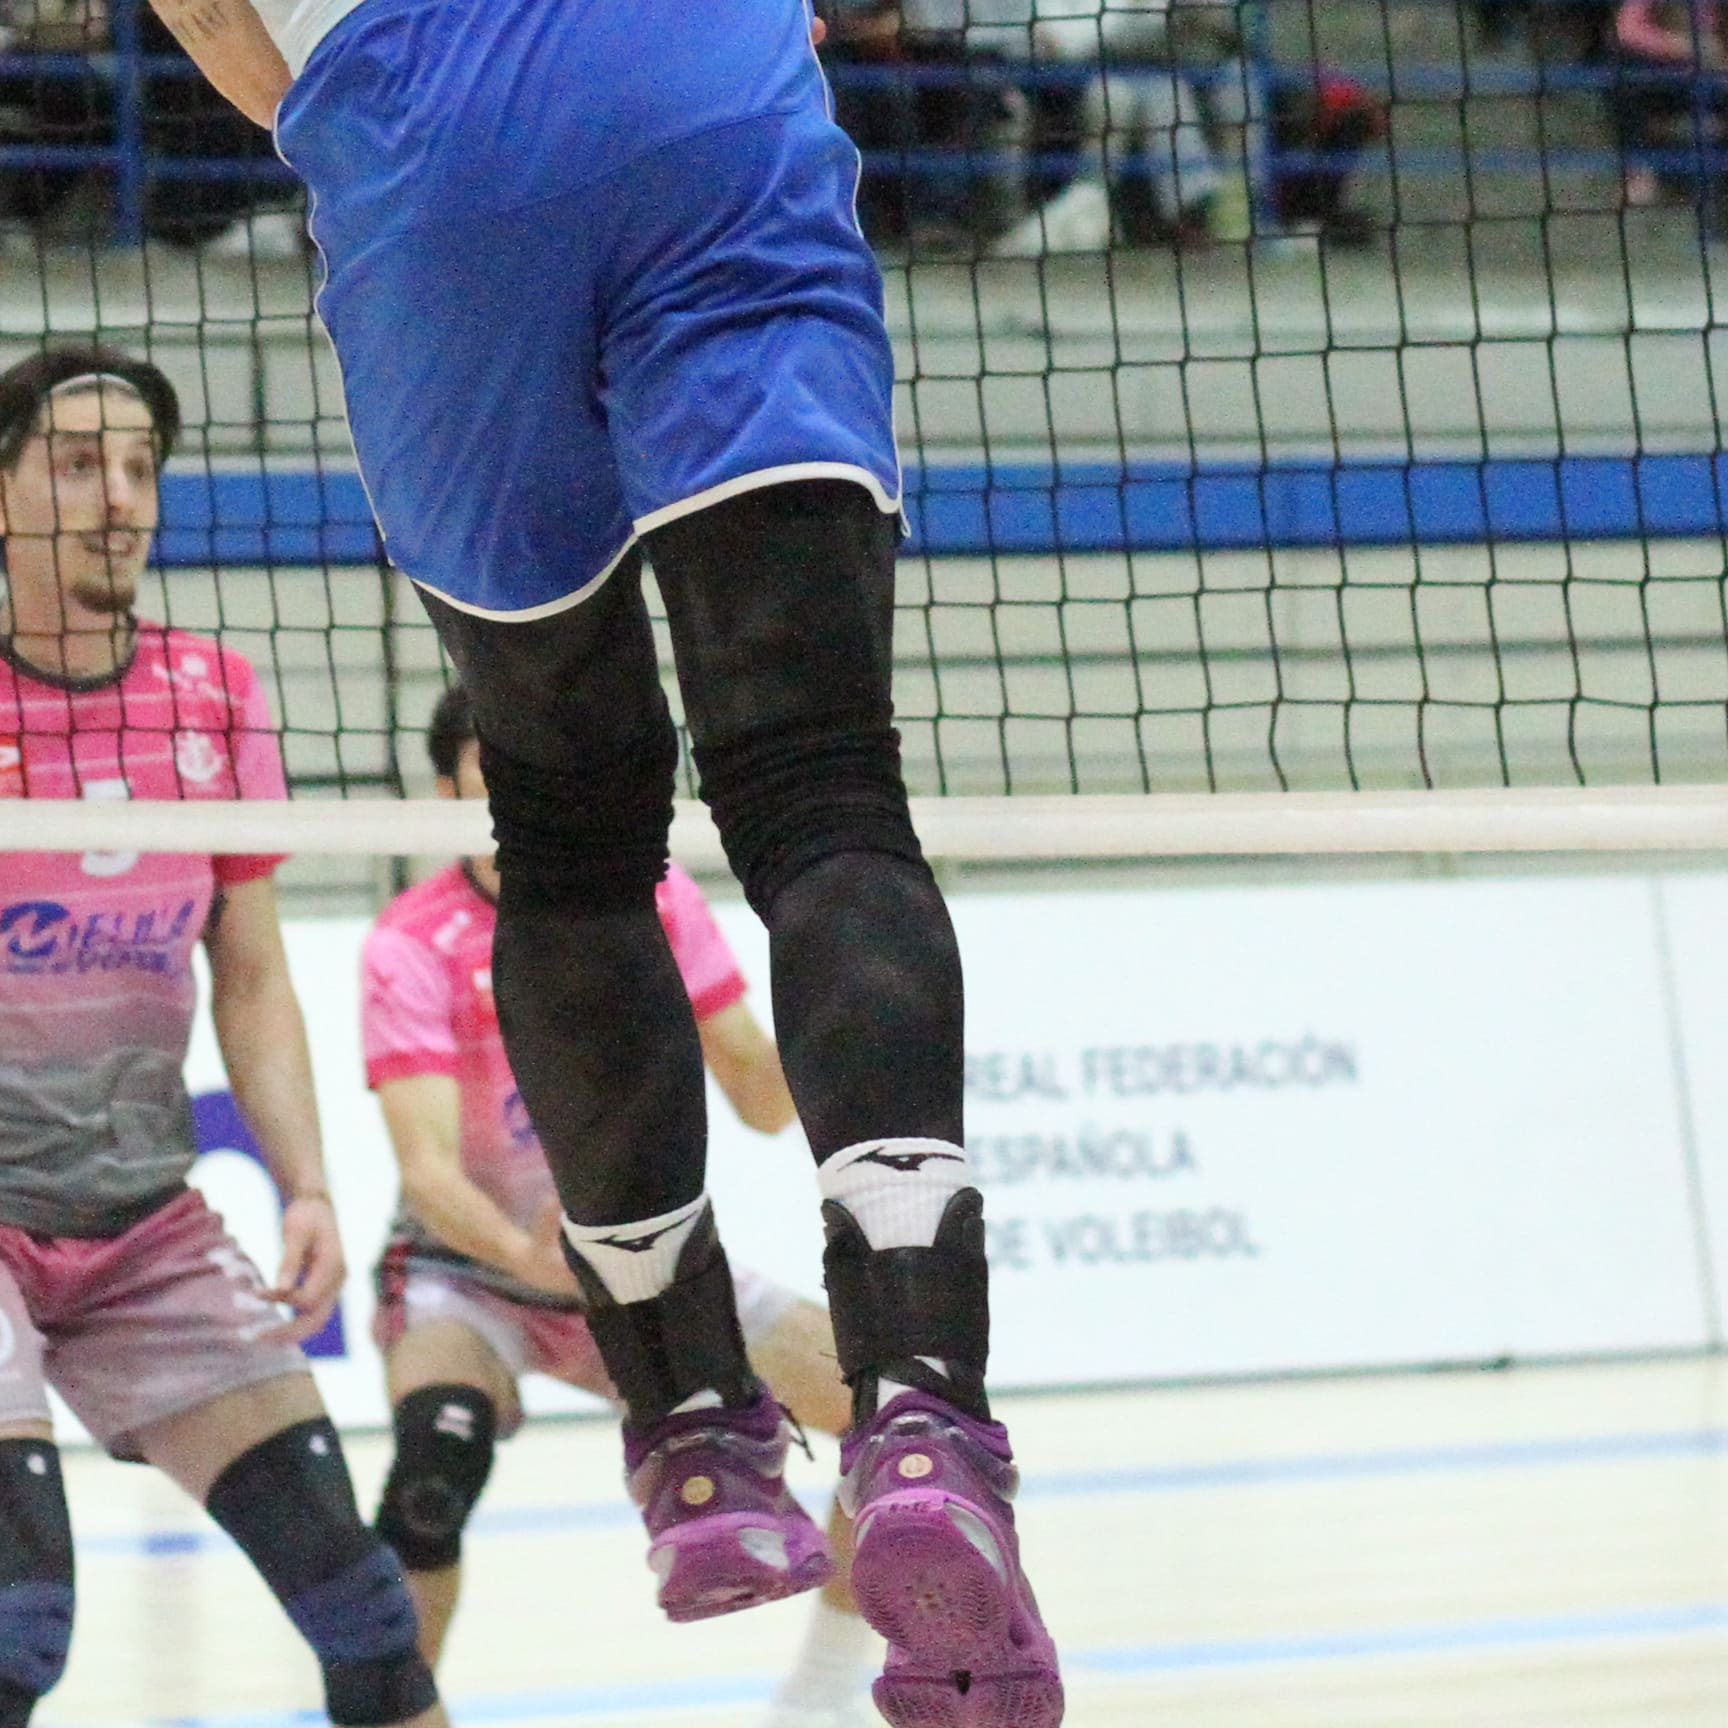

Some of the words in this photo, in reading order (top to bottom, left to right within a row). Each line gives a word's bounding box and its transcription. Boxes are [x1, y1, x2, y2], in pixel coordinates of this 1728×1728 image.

[1081, 1031, 1360, 1096] FEDERACIÓN
[966, 1122, 1197, 1184] ESPAÑOLA
[1045, 1207, 1262, 1264] VOLEIBOL
